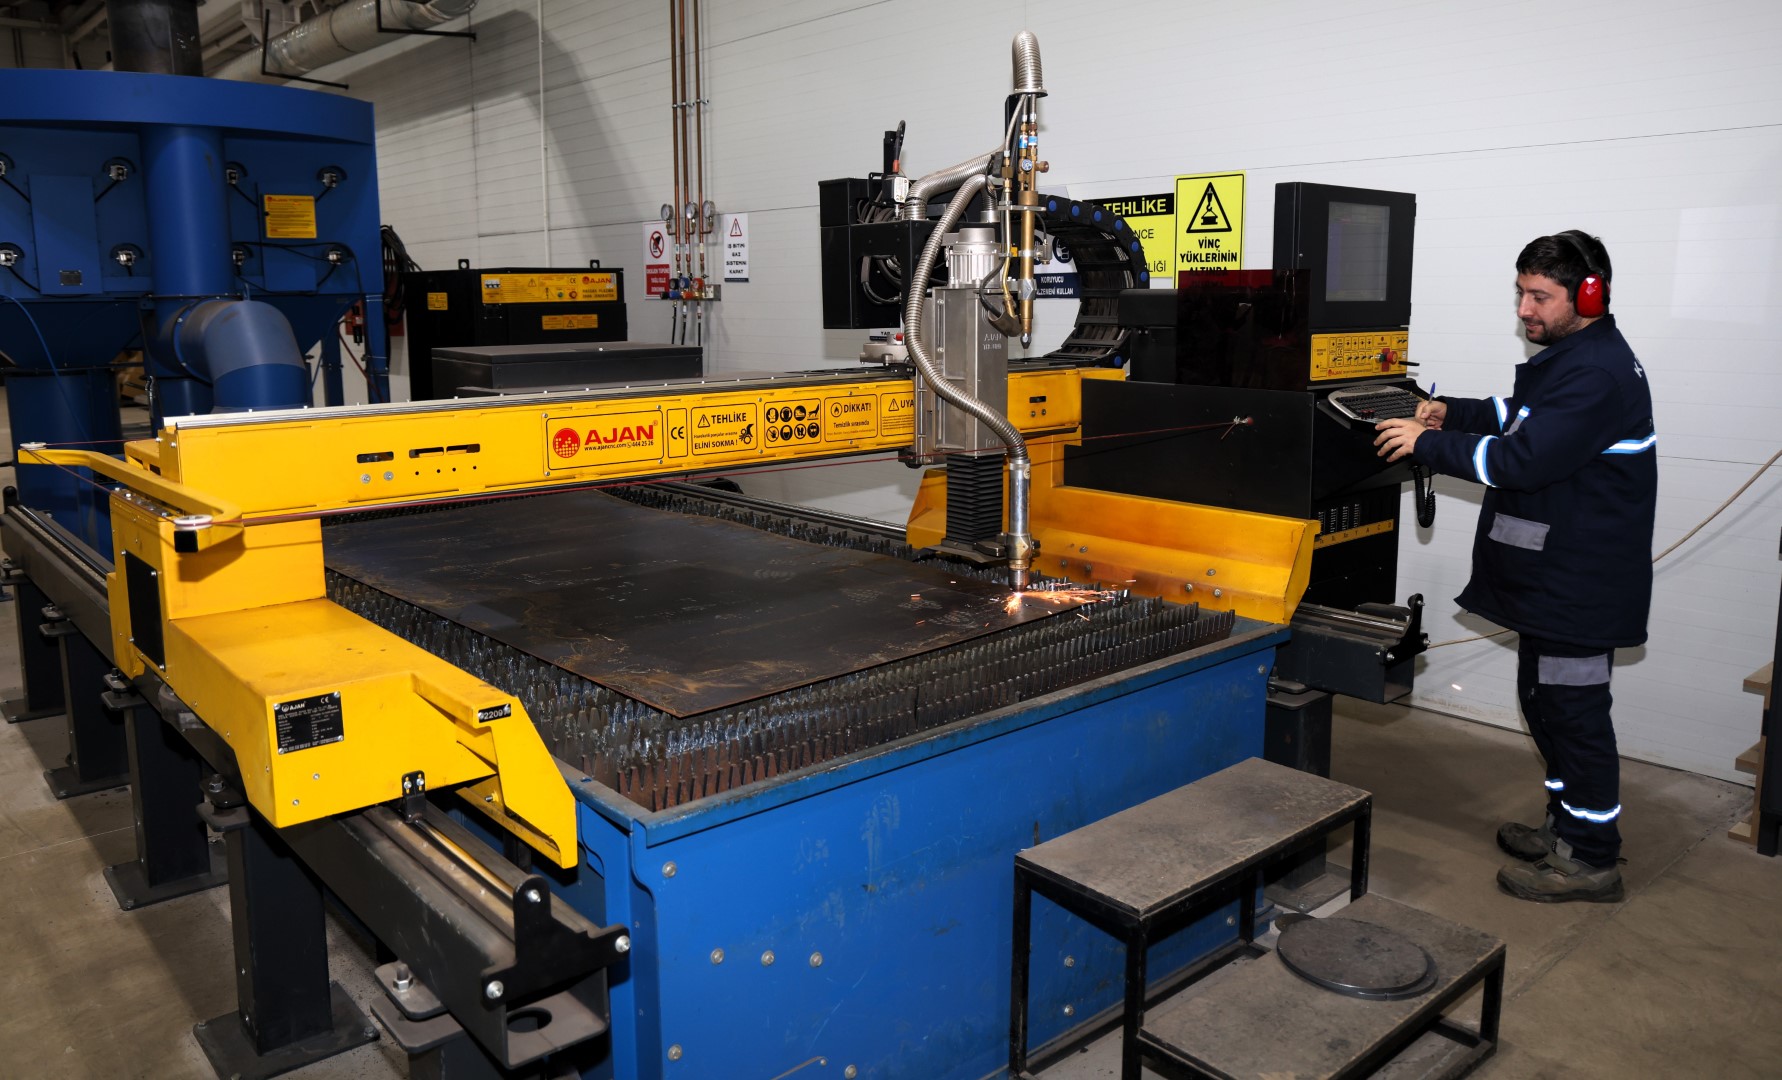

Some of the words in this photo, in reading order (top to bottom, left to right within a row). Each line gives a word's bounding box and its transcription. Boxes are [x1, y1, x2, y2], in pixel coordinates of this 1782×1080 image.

[1103, 197, 1167, 216] TEHLİKE
[1198, 235, 1221, 251] VİNÇ
[1180, 251, 1237, 263] YÜKLERİNİN
[1040, 275, 1065, 284] KORUYUCU
[1056, 287, 1074, 295] KULLAN
[843, 402, 872, 413] DİKKAT!
[711, 411, 747, 425] TEHLİKE
[584, 424, 654, 446] AJAN
[694, 440, 711, 450] ELİNİ
[711, 439, 735, 448] SOKMA
